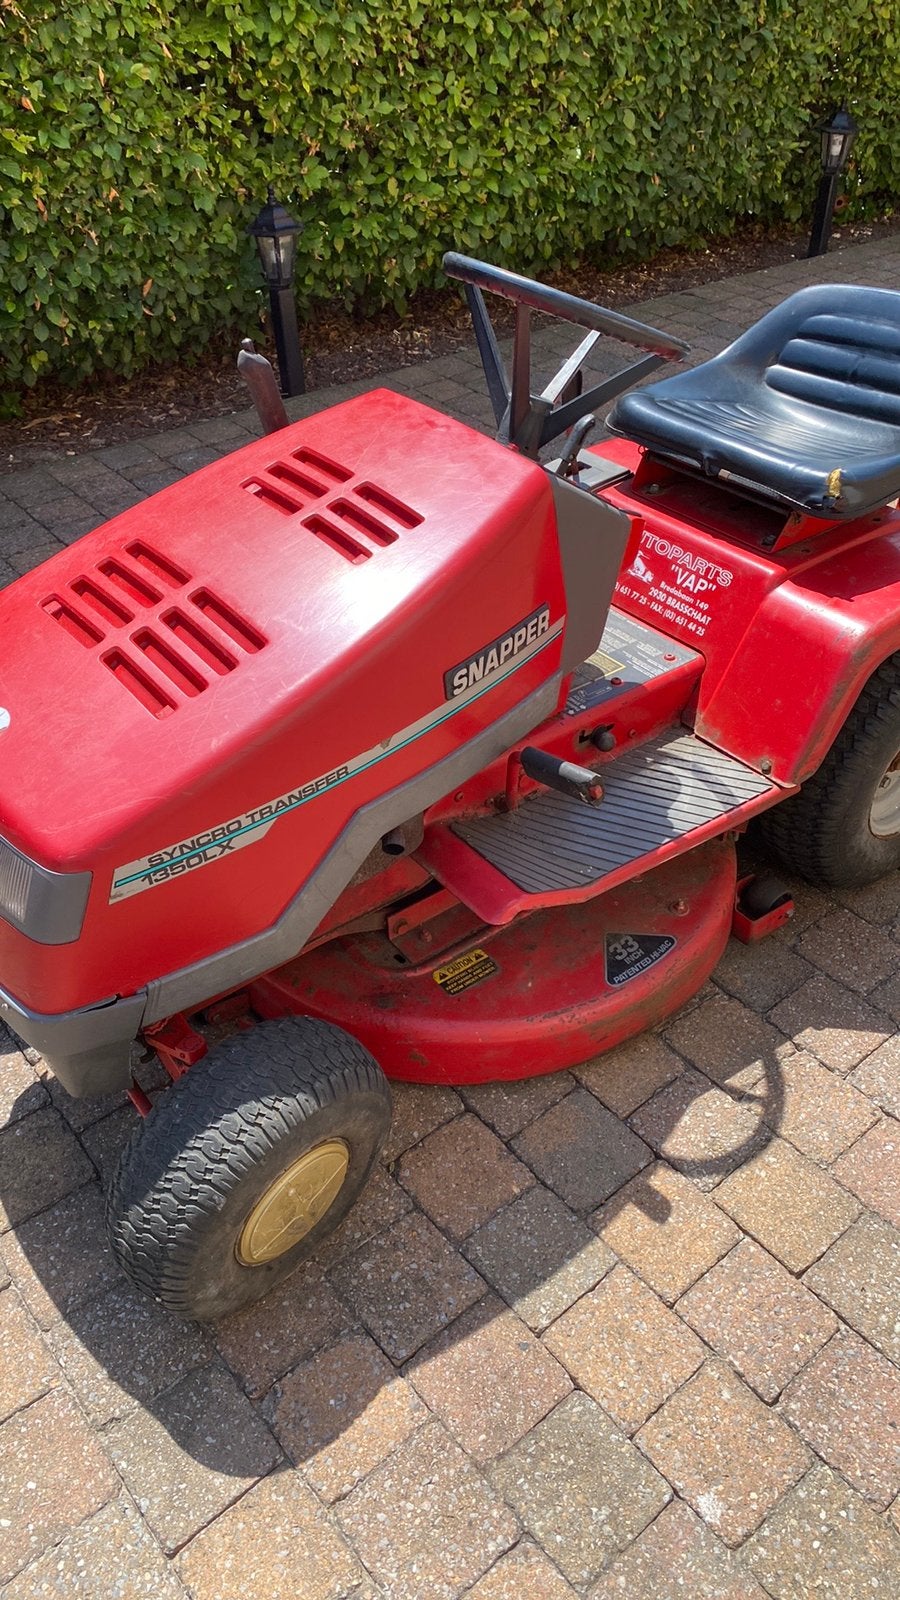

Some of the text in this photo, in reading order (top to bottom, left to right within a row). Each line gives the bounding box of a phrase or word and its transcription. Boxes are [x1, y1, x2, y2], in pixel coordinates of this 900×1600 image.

[660, 581, 709, 611] Bredabaan 149
[671, 564, 717, 593] "VAP"
[620, 585, 631, 595] 651
[631, 590, 640, 599] 77
[639, 595, 647, 605] 25
[650, 601, 663, 615] FAX:
[663, 608, 675, 622] (03)
[675, 615, 687, 627] 651
[696, 626, 706, 637] 25
[648, 587, 667, 602] 2930
[666, 597, 712, 625] BRASSCHAAT
[453, 609, 550, 696] SNAPPER
[147, 765, 350, 870] SYNCRO TRANSFER
[141, 839, 236, 886] 1350LX
[446, 956, 474, 974] CAUTION
[608, 935, 640, 961] 33
[613, 940, 672, 983] PATENTED HI-VAC
[624, 948, 645, 965] INCH
